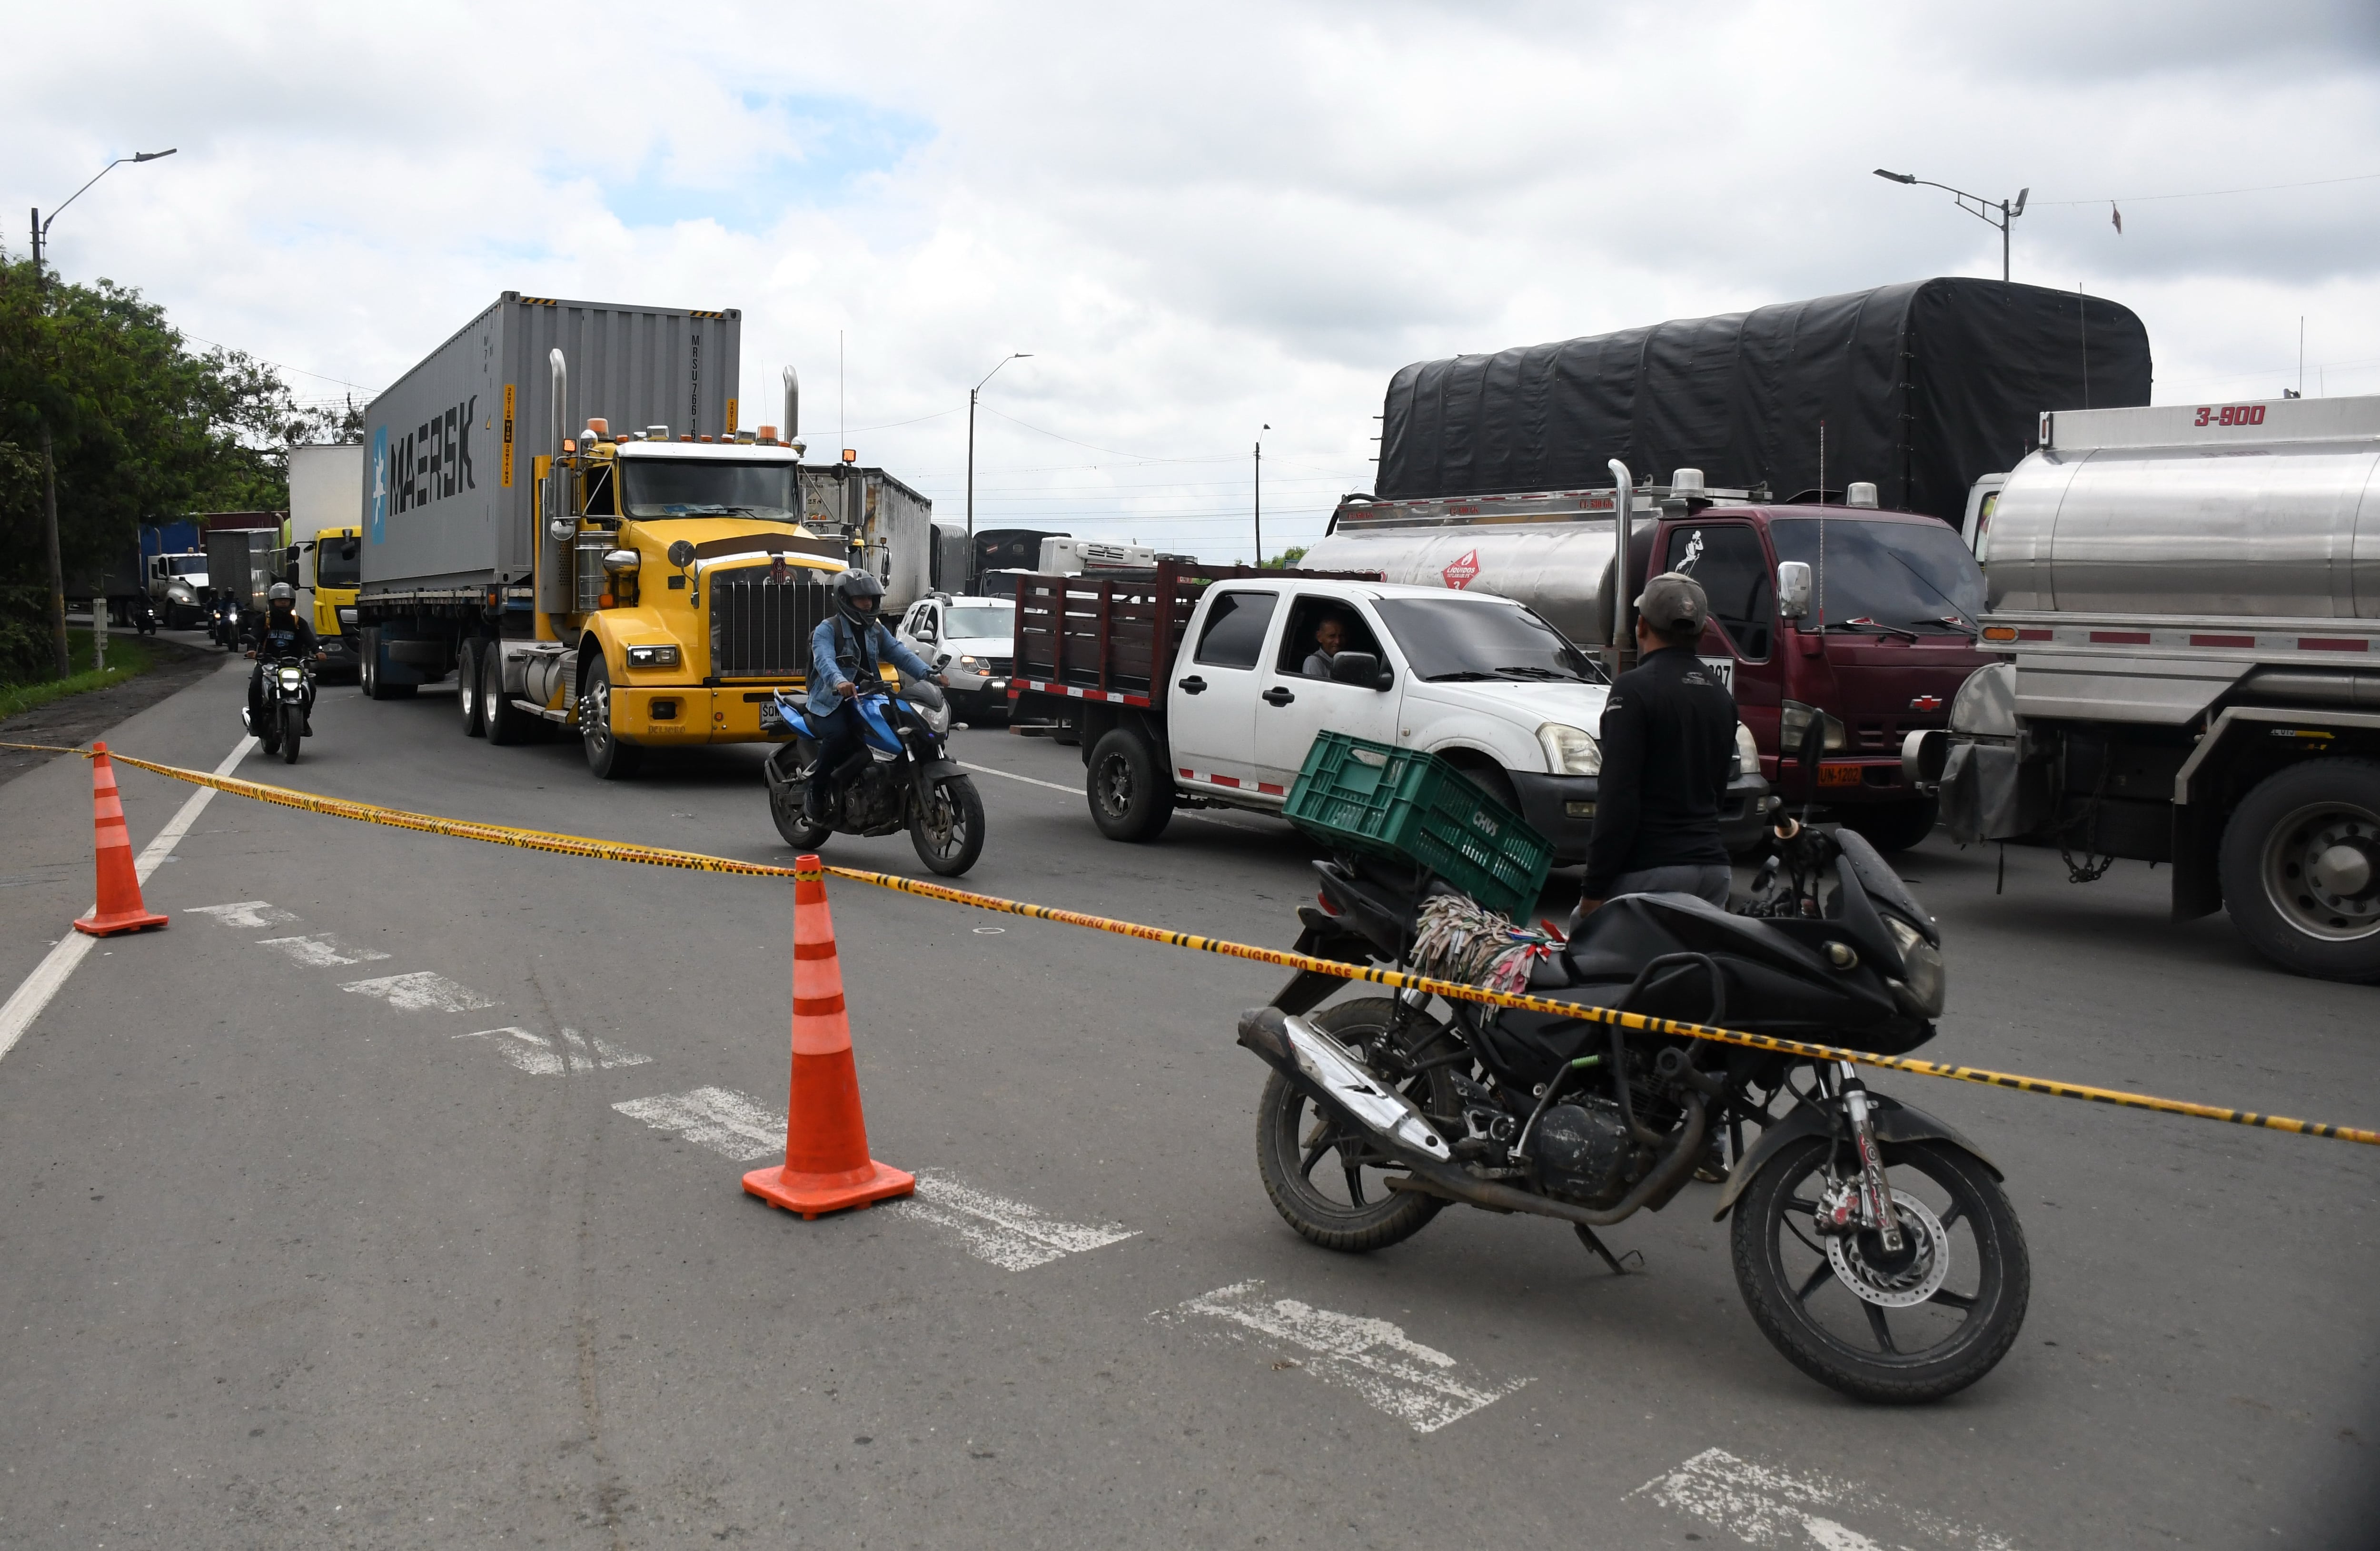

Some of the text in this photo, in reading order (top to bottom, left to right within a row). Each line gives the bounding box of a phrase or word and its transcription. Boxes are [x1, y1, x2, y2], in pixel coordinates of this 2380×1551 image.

[2194, 405, 2265, 426] 3-900
[389, 395, 477, 516] MAERSK
[1708, 664, 1731, 687] 97
[1820, 767, 1858, 782] UN-1202
[1053, 911, 1163, 941] PELIGRO NO PASE
[1222, 944, 1351, 978] PELIGRO NO PASE
